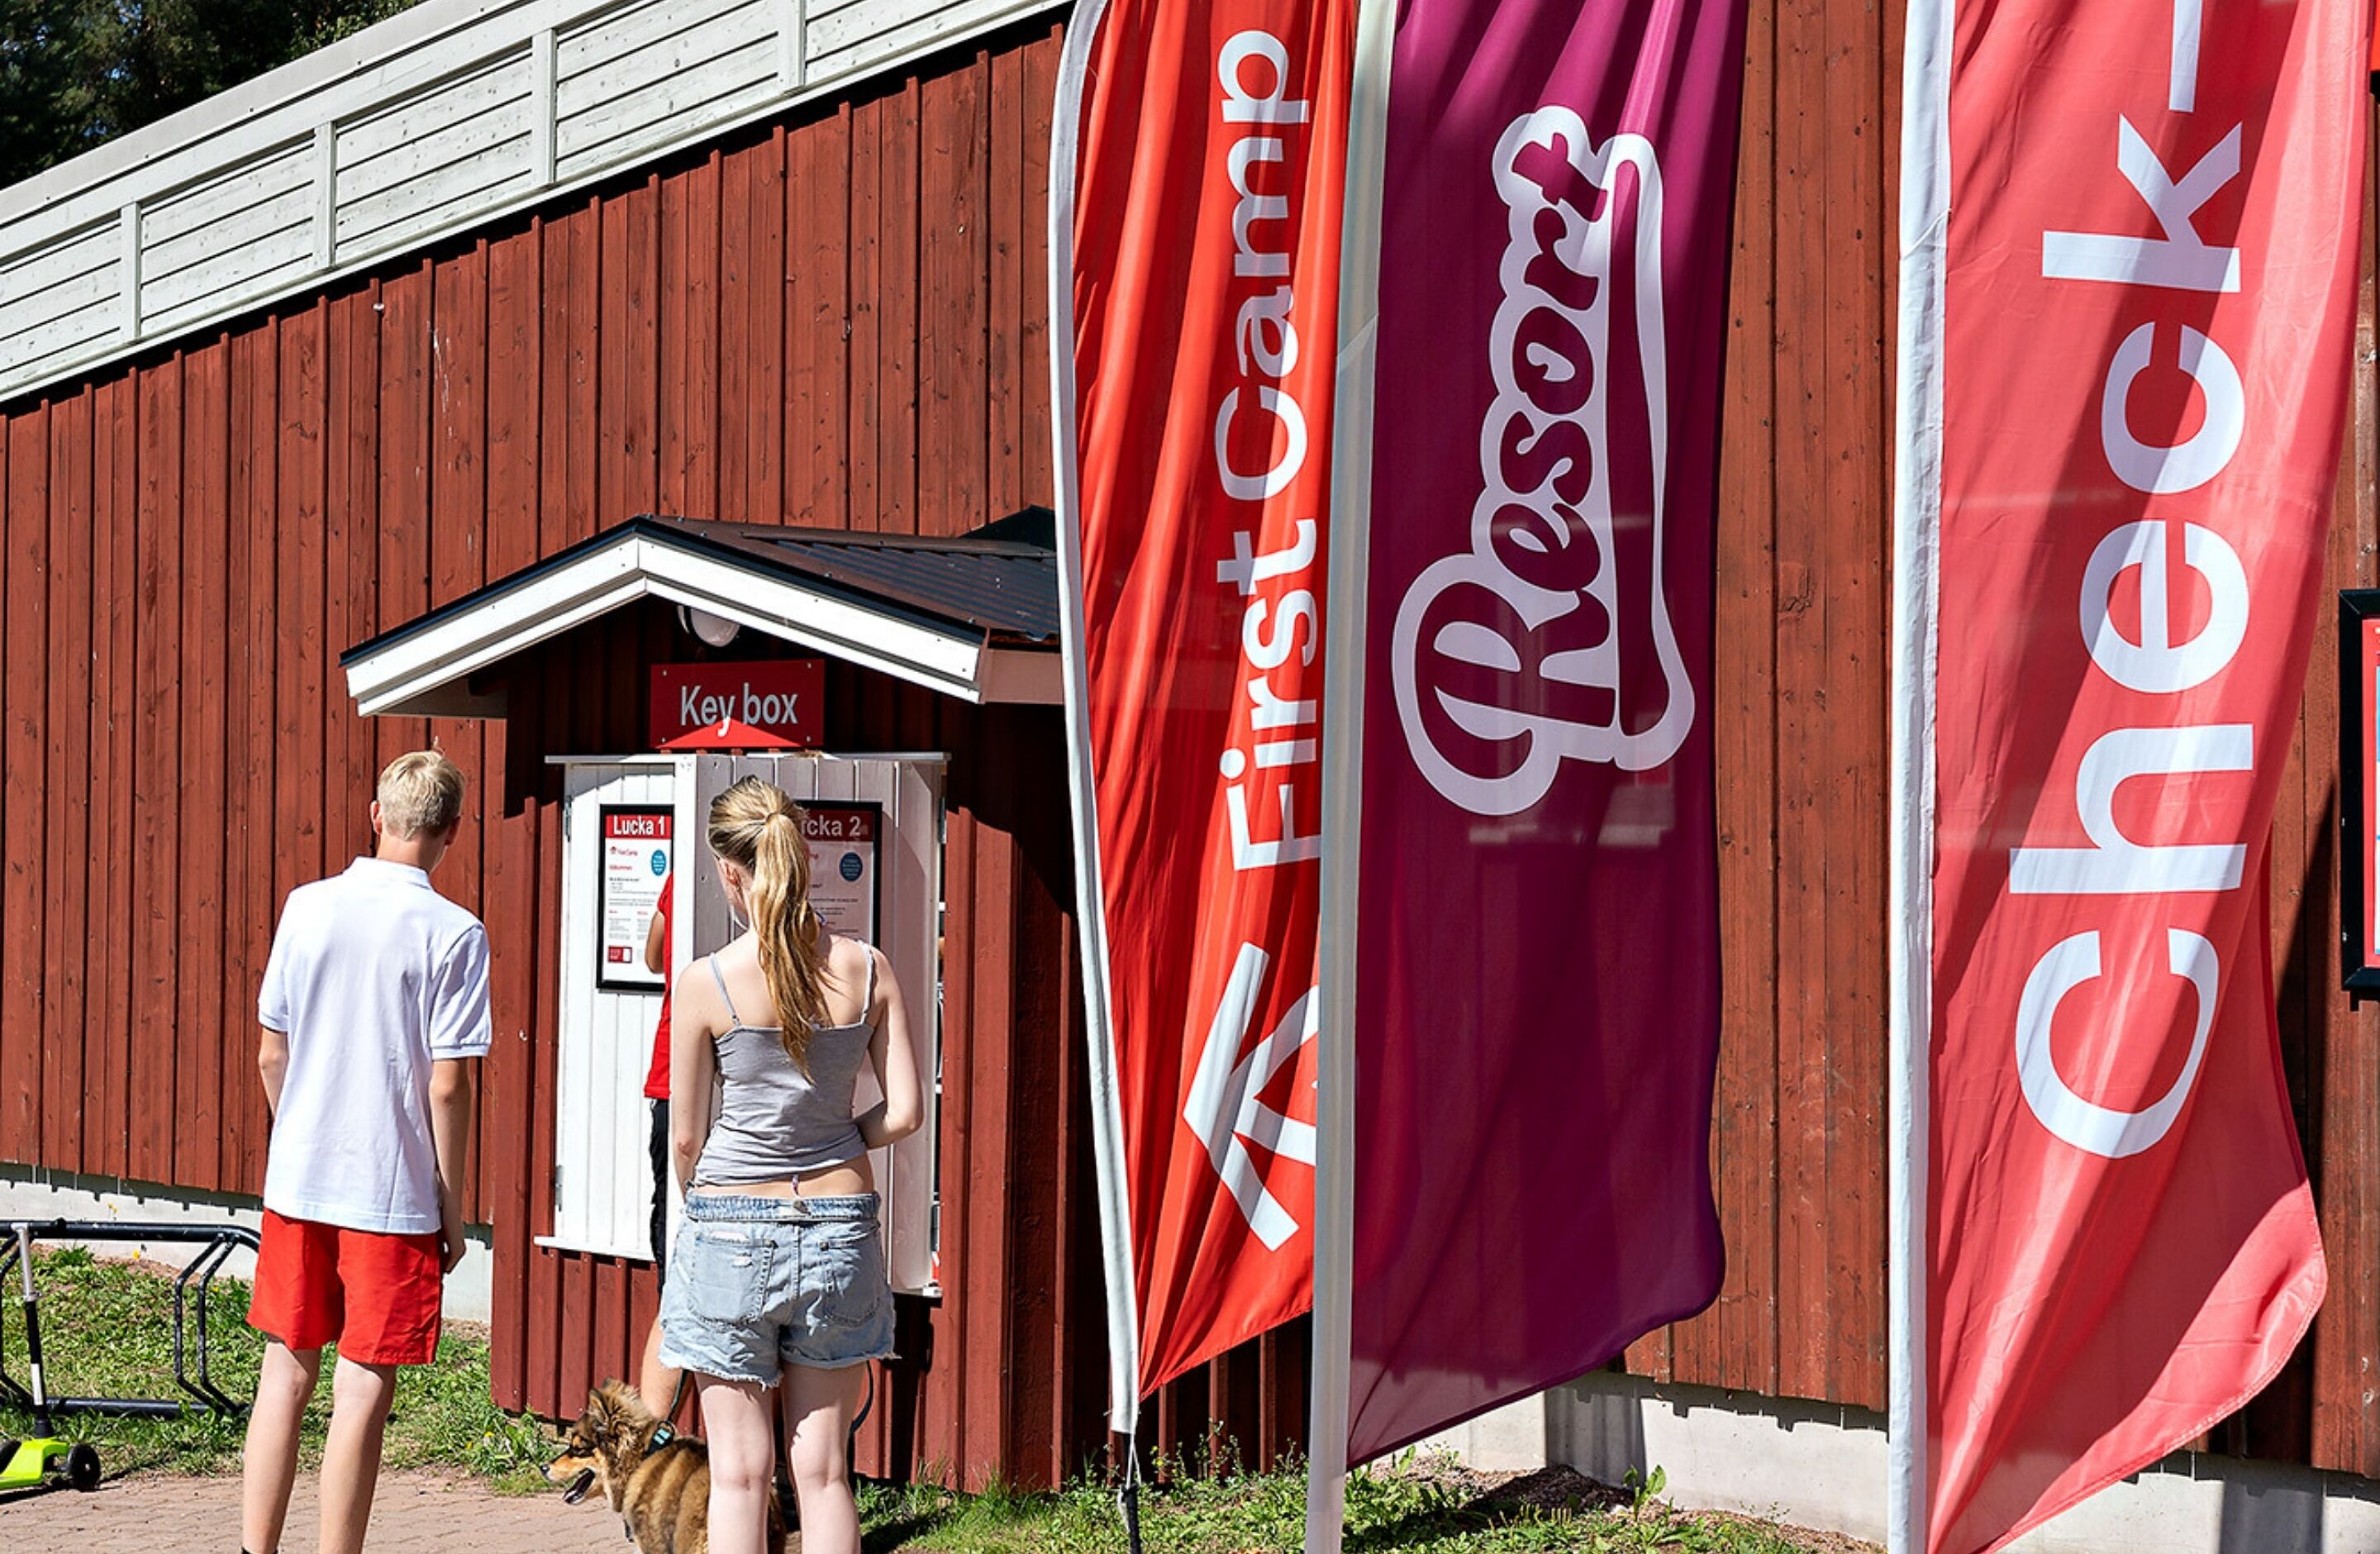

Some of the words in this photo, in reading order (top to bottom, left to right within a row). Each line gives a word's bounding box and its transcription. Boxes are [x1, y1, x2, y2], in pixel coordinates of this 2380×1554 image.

[1215, 30, 1309, 501] Camp
[1392, 105, 1630, 816] Resort
[680, 684, 735, 736] Key
[743, 682, 798, 725] box
[1216, 518, 1322, 871] First
[613, 814, 654, 836] Lucka
[658, 815, 665, 836] 1
[800, 814, 843, 837] cka
[849, 815, 862, 837] 2
